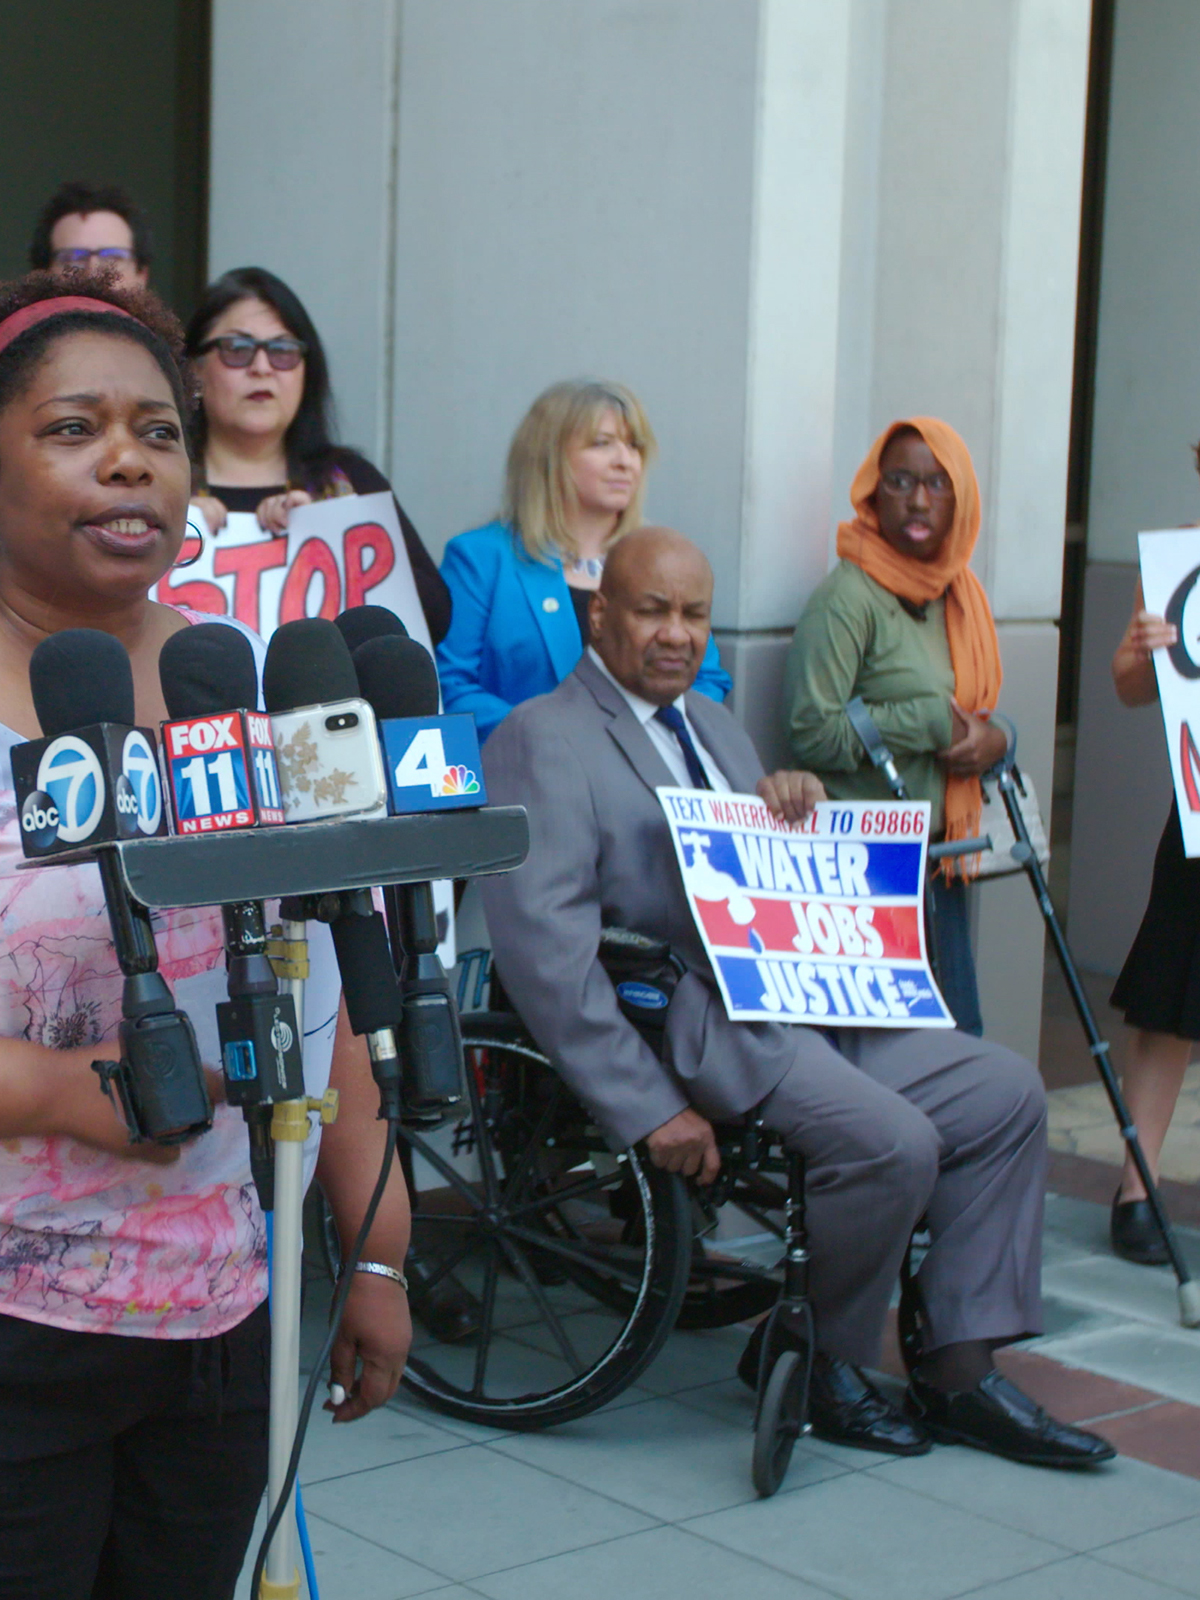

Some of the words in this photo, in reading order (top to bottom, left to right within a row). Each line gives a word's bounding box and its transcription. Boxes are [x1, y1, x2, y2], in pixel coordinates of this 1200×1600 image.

[157, 522, 395, 633] STOP
[170, 717, 237, 756] FOX
[248, 714, 272, 747] FOX
[181, 752, 239, 815] 11
[256, 750, 279, 808] 11
[395, 728, 447, 797] 4
[22, 804, 60, 833] abc
[116, 790, 139, 815] abc
[183, 811, 249, 832] NEWS
[260, 809, 284, 823] NEWS
[665, 795, 707, 823] TEXT
[709, 799, 820, 834] WATERFORL
[830, 810, 854, 834] TO
[860, 810, 925, 835] 69866
[731, 832, 871, 897] WATER
[789, 901, 884, 959] JOBS
[756, 960, 910, 1018] JUSTICE
